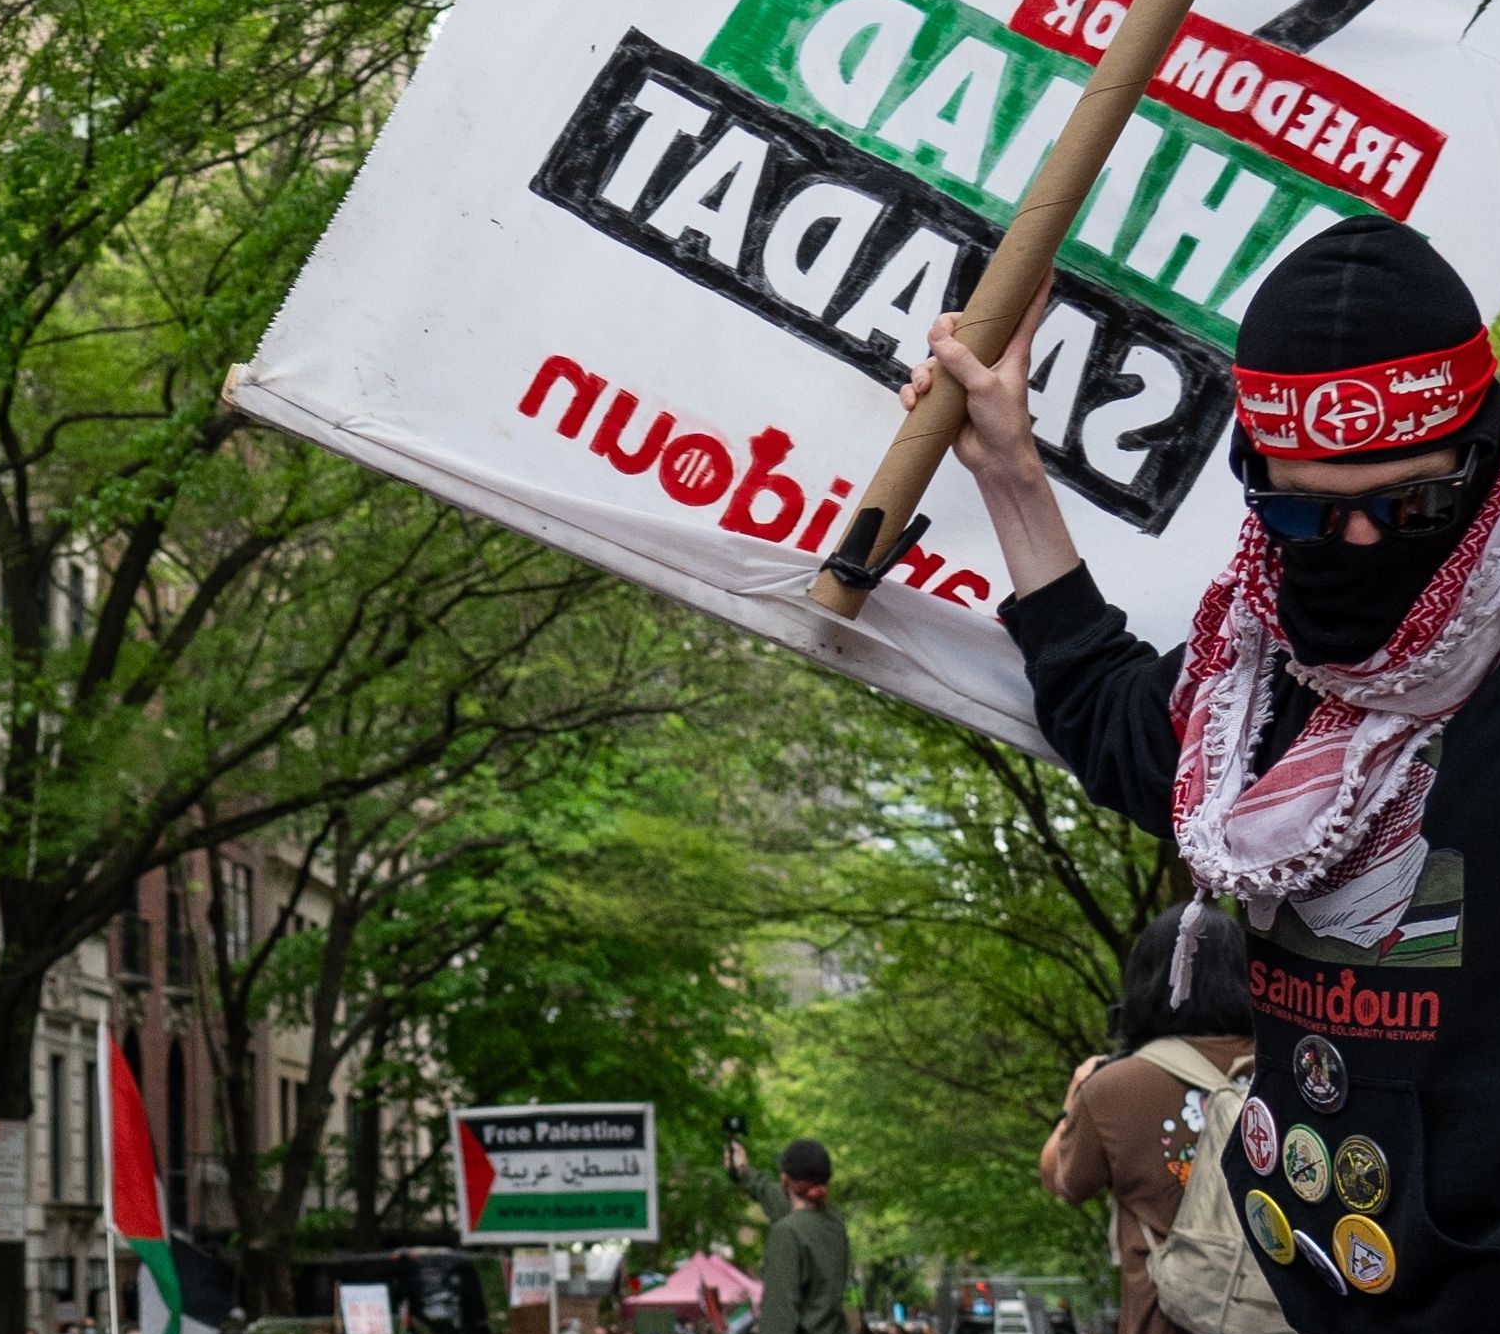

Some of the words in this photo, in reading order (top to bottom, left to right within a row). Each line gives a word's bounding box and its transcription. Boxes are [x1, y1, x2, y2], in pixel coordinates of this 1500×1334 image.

[1248, 960, 1440, 1029] samidoun
[1329, 1024, 1385, 1040] SOLIDARITY
[1384, 1028, 1437, 1042] NETWORK
[482, 1124, 533, 1146] Free
[534, 1120, 636, 1143] Palestine
[561, 1154, 640, 1187] فلسطين
